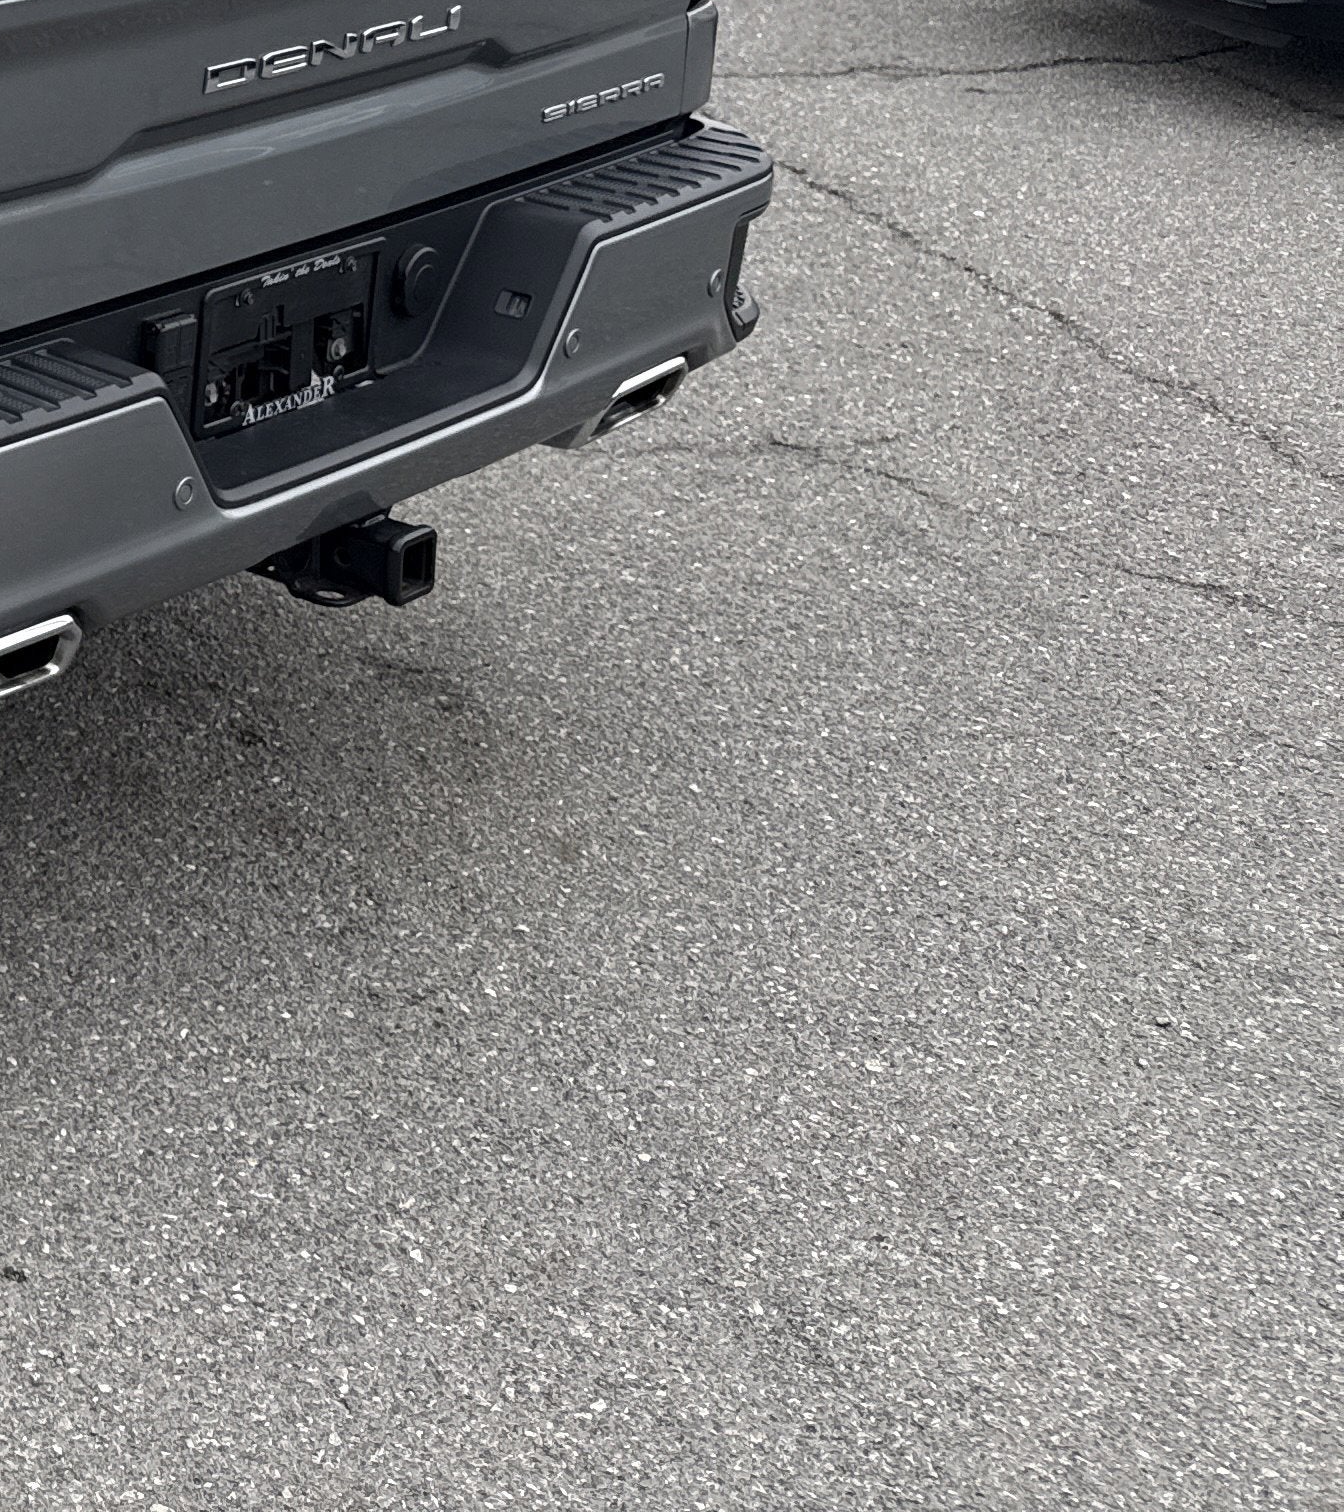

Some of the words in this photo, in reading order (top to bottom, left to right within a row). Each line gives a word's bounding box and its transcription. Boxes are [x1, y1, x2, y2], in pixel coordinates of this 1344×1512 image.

[202, 4, 463, 95] DENALI
[540, 72, 665, 124] SIERRA
[242, 375, 336, 426] ALEXANDER
